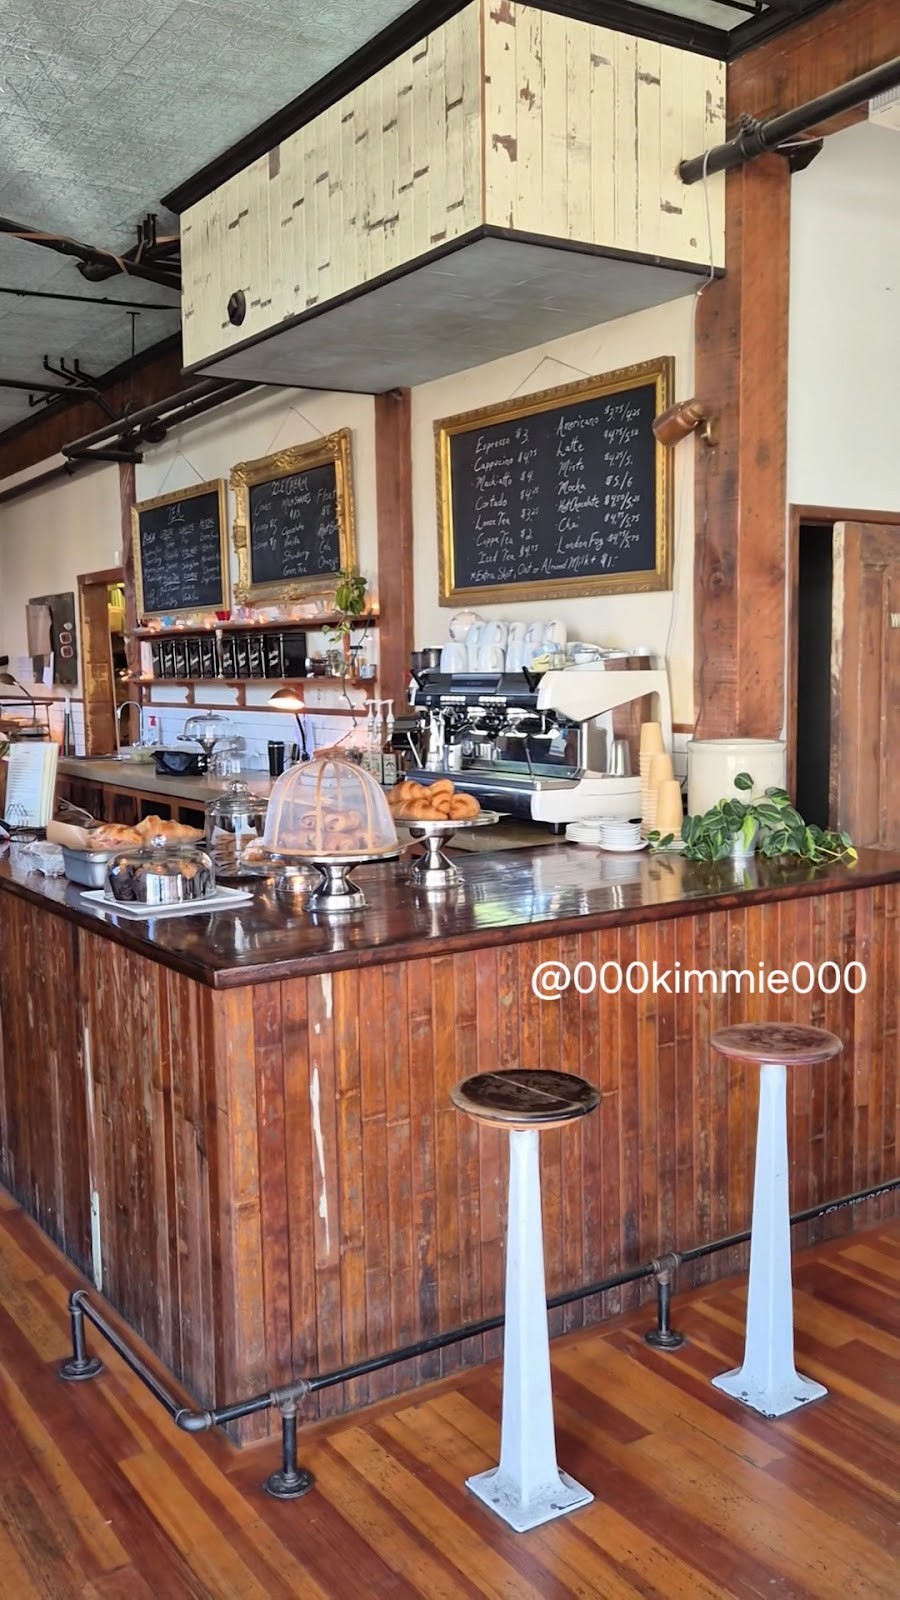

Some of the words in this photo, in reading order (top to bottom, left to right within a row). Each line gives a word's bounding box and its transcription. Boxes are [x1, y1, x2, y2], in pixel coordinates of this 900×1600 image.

[556, 415, 600, 437] Americano
[475, 436, 510, 454] Espresso
[556, 436, 585, 457] Latte
[558, 458, 585, 478] Misto
[557, 477, 586, 495] Mocha
[475, 492, 508, 511] Cortado
[475, 514, 497, 530] Loose
[498, 511, 510, 526] Tea
[500, 530, 514, 547] Tea
[557, 536, 588, 555] London
[588, 531, 604, 552] Fog
[478, 551, 499, 564] Iced
[502, 548, 516, 562] Tea
[567, 554, 589, 572] Milk
